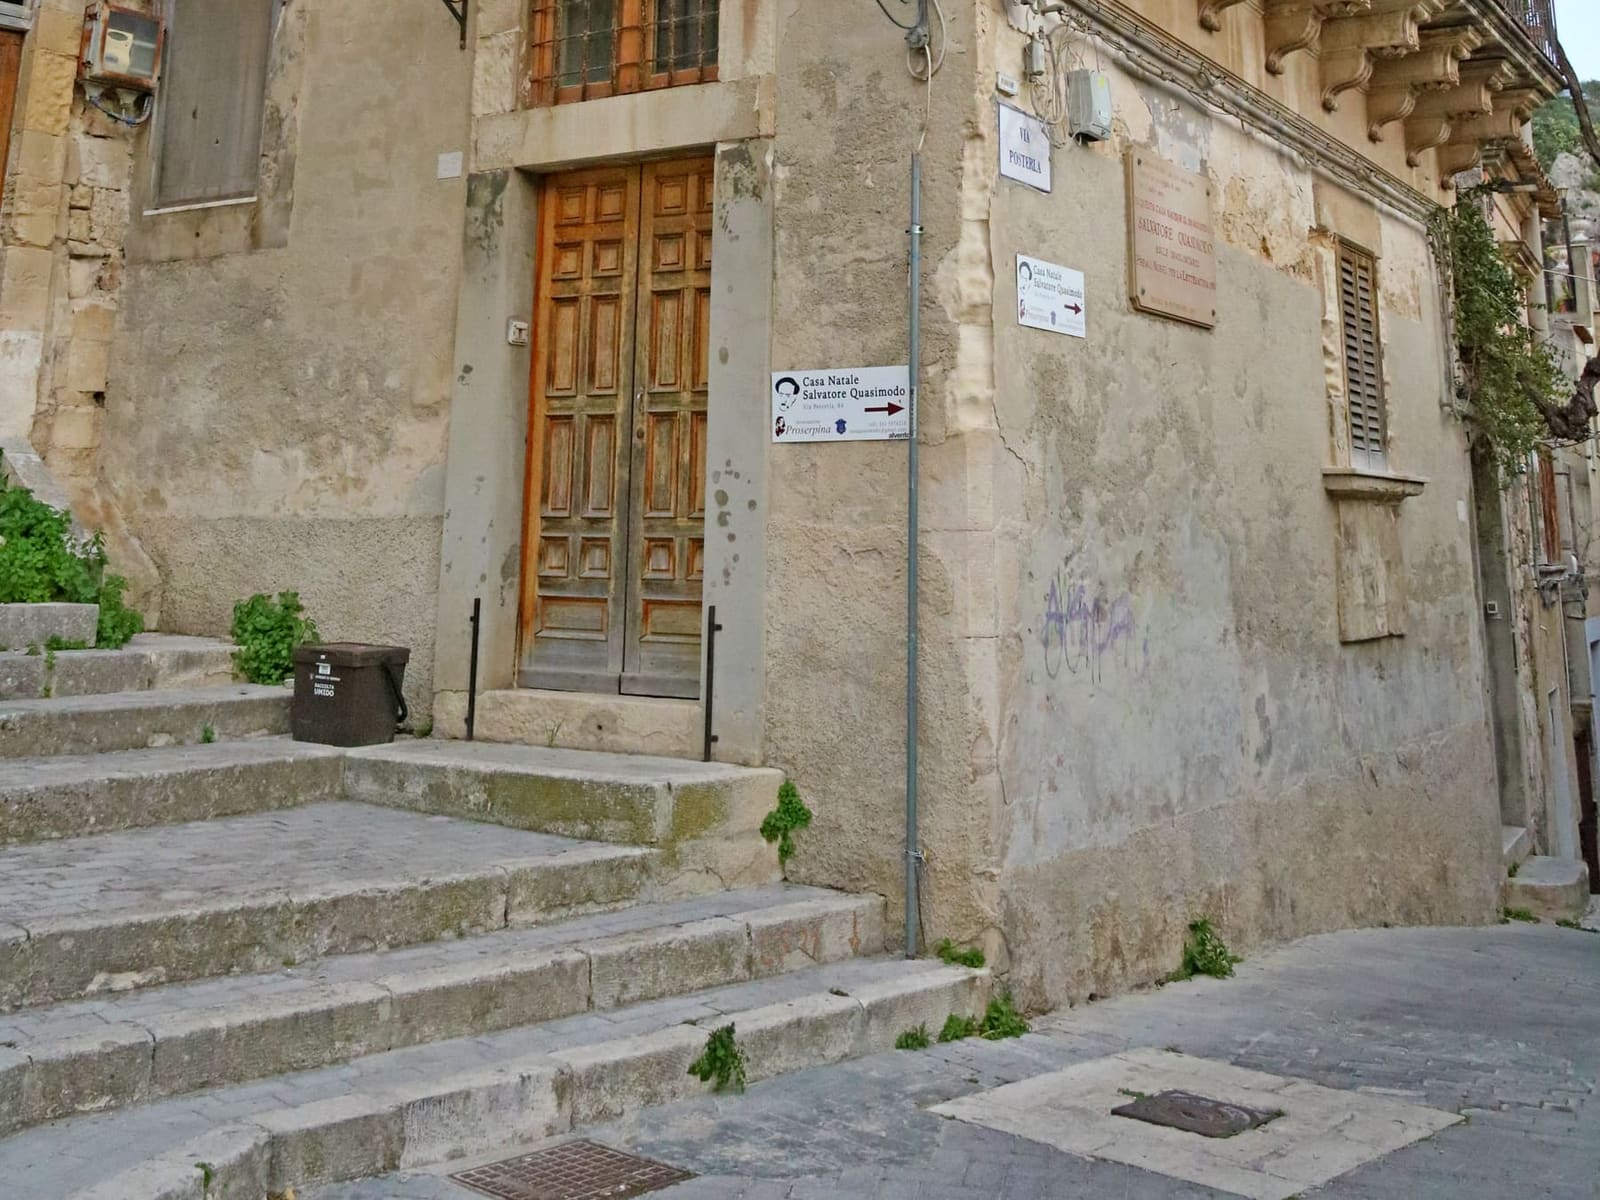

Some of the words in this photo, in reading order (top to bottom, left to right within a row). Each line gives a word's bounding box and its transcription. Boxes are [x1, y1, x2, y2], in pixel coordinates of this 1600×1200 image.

[1019, 127, 1031, 144] VIA
[1009, 149, 1042, 174] POSTERLA
[802, 376, 825, 387] Casa
[828, 374, 859, 386] Natale
[802, 388, 847, 400] Salvatore
[850, 385, 905, 400] Quasimodo
[786, 424, 831, 437] Proserpina
